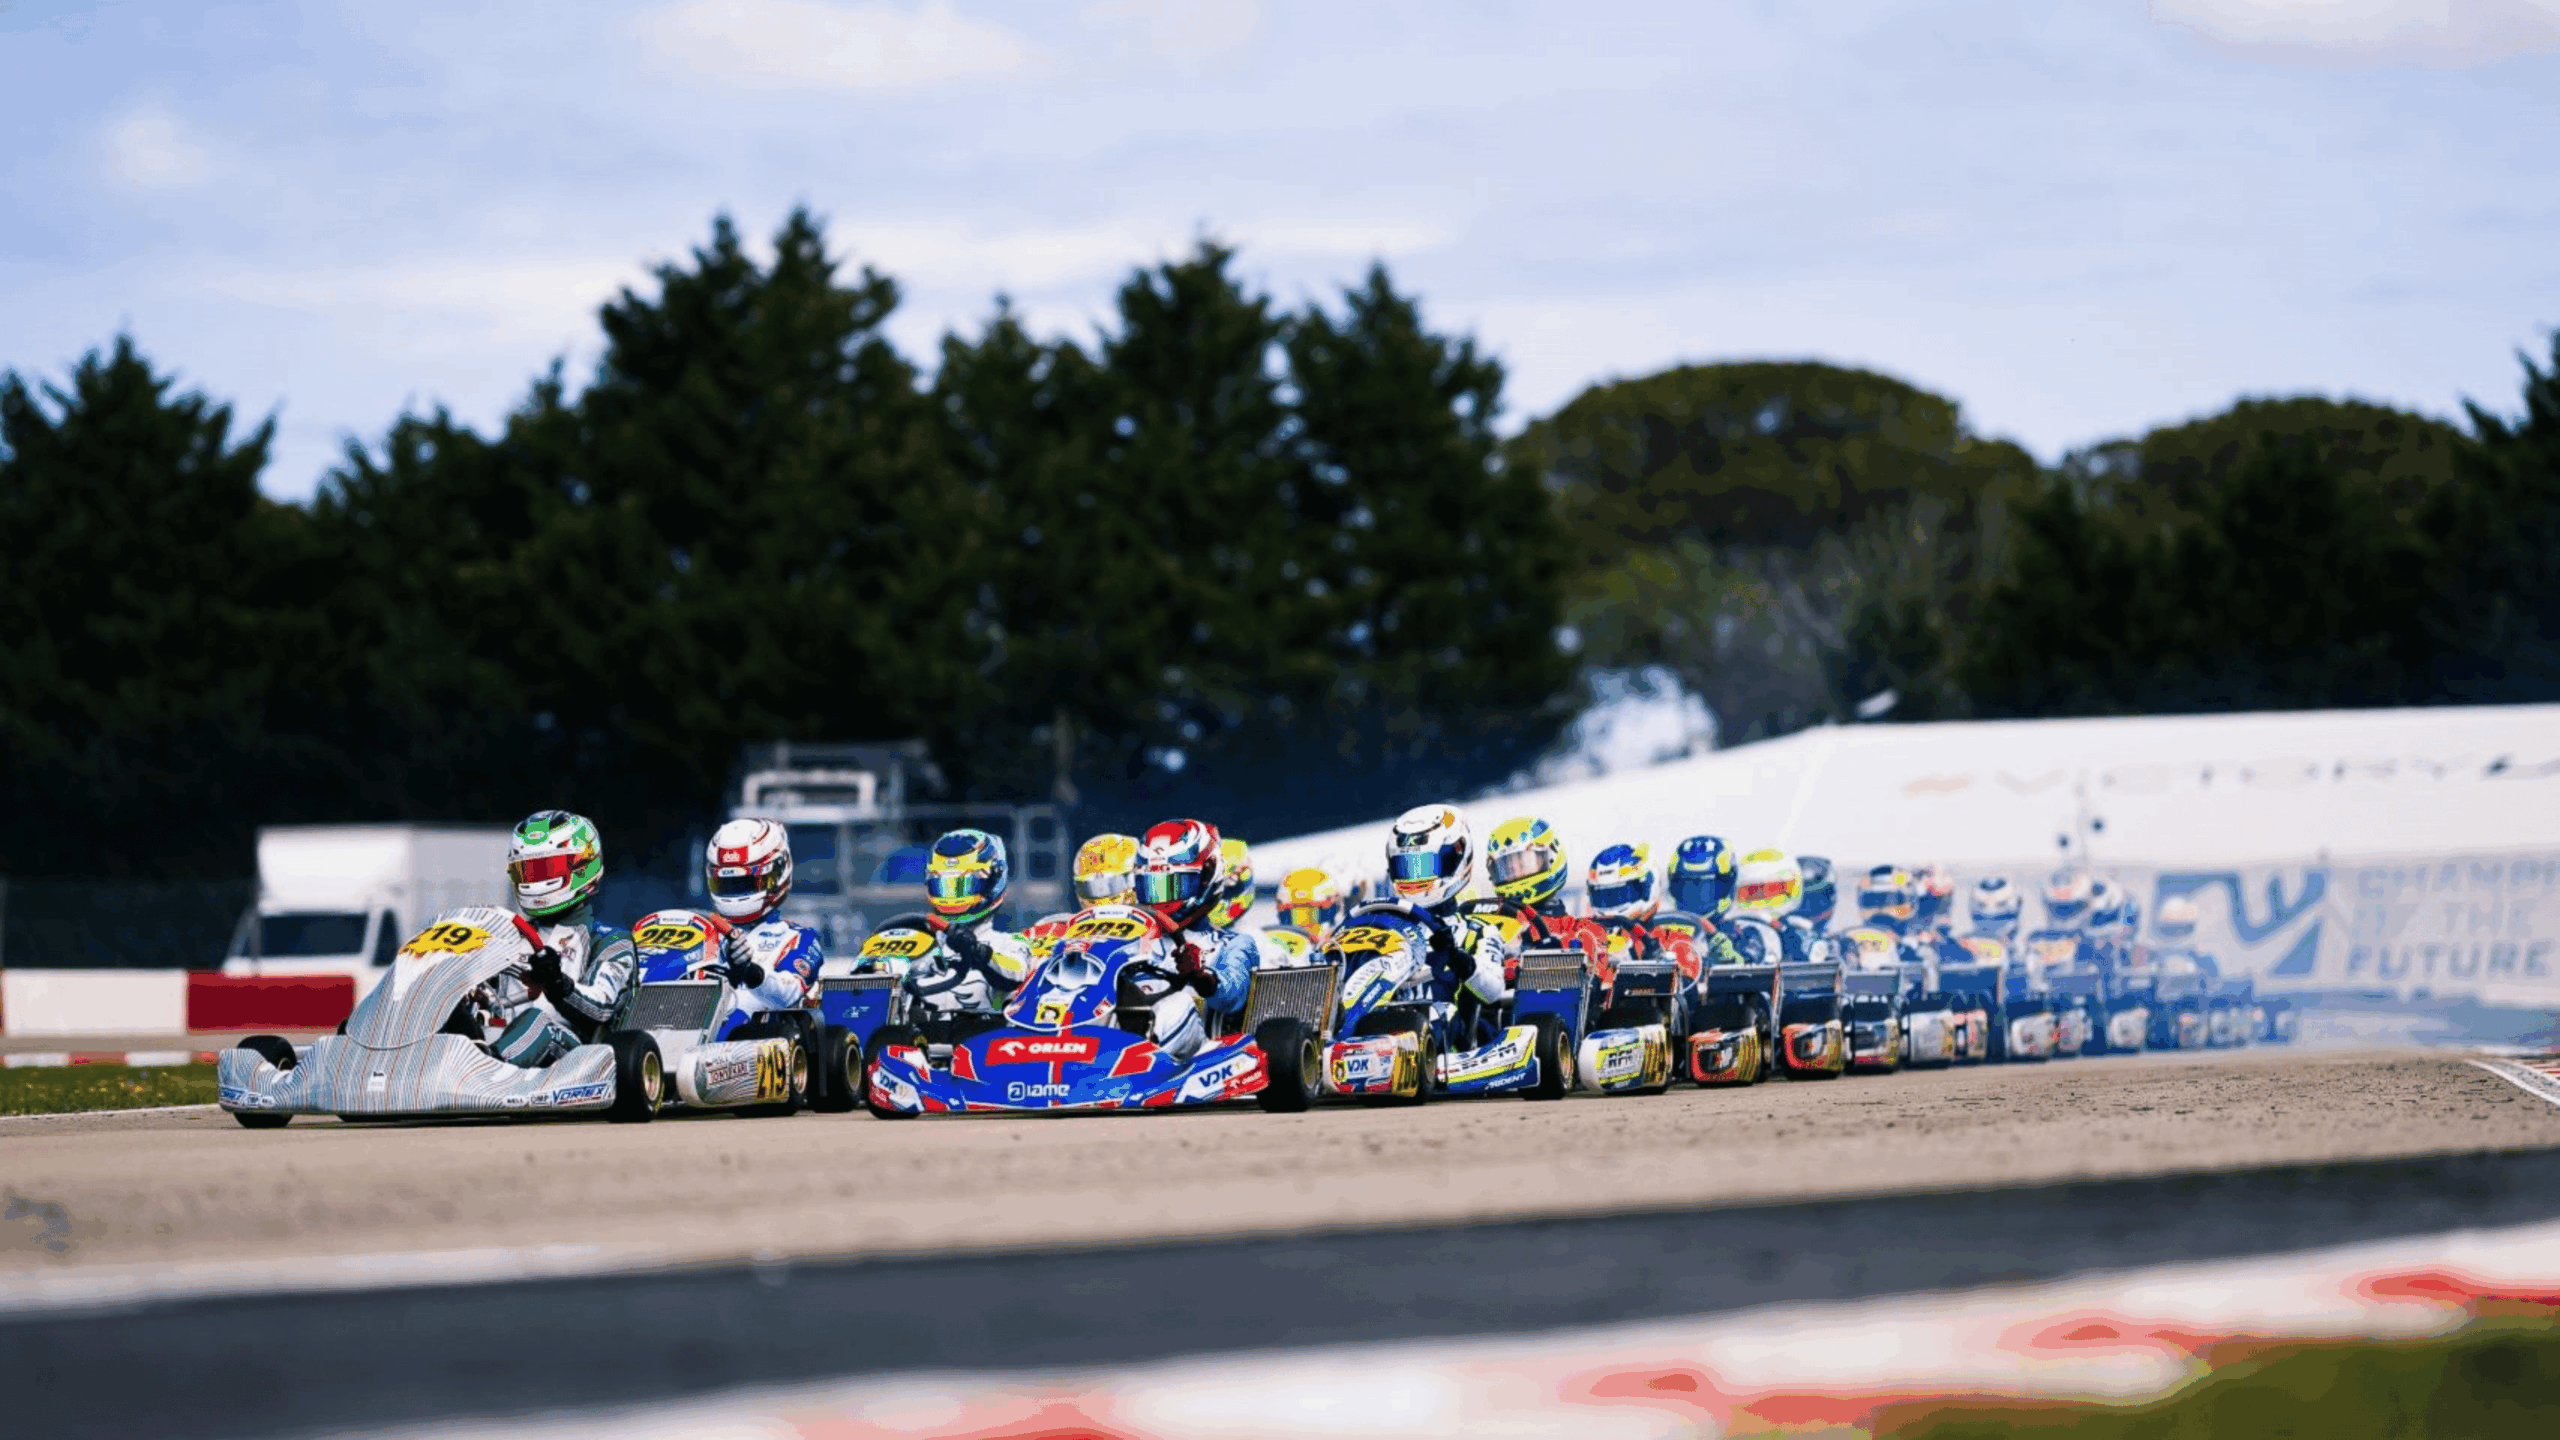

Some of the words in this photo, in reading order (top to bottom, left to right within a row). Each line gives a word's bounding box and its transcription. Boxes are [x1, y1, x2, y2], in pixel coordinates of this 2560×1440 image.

[2347, 939, 2556, 981] FUTURE
[1028, 1042, 1087, 1054] ORLEN
[1348, 1058, 1369, 1072] VDK
[1199, 1064, 1233, 1088] VDK
[552, 1083, 607, 1102] VORTEX
